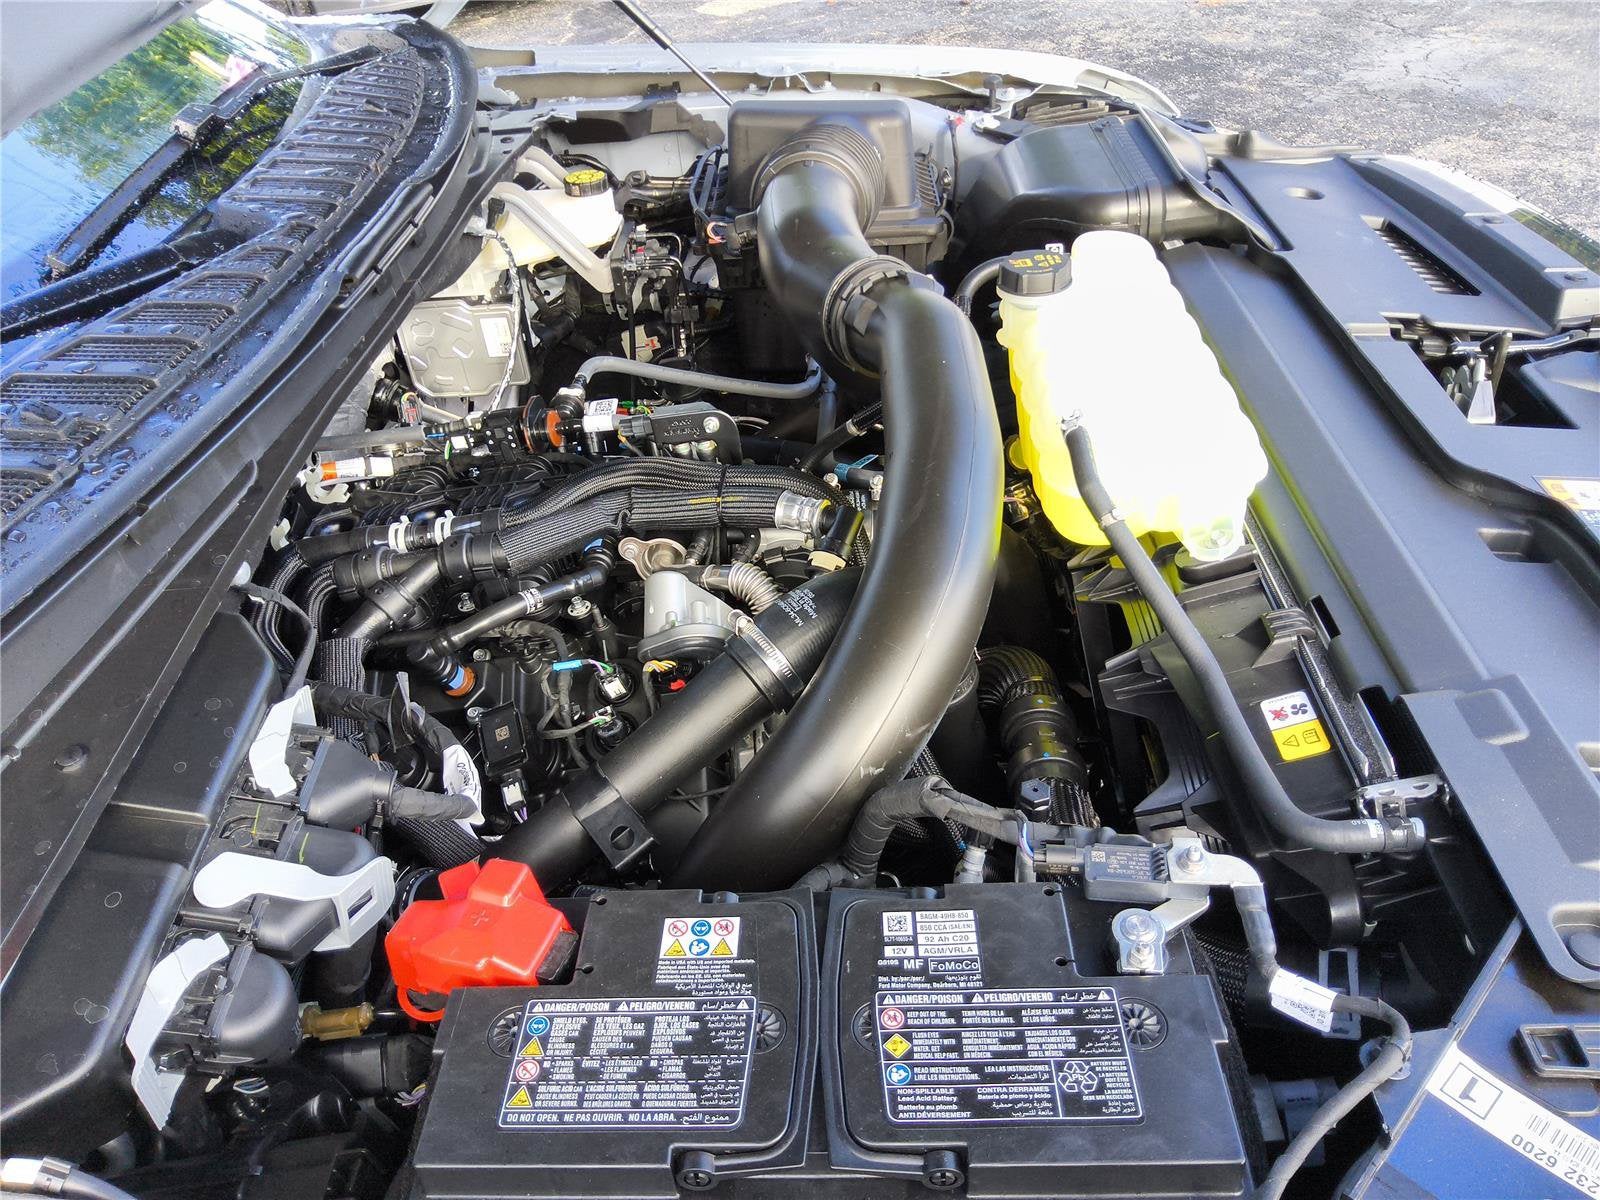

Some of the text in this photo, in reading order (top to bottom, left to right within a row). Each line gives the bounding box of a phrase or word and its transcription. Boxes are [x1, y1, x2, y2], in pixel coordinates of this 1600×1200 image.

[903, 959, 924, 969] MF
[931, 961, 979, 970] FoMoCo
[907, 982, 932, 990] Company,
[895, 994, 964, 1004] DANGER/POISON
[984, 992, 1054, 1003] PELIGRO/VENENO
[544, 1003, 609, 1012] DANGER/POISON
[629, 1001, 695, 1011] PELIGRO/VENENO
[939, 1073, 980, 1081] INSTRUCTIONS.
[932, 1094, 958, 1103] Battery
[936, 1103, 957, 1111] plomb
[592, 1113, 624, 1121] OUVRIR.
[628, 1113, 641, 1121] NO
[641, 1113, 652, 1121] LA
[652, 1113, 676, 1121] ABRA.
[918, 1109, 972, 1118] DÉVERSEMENT
[1511, 1134, 1557, 1168] 6200
